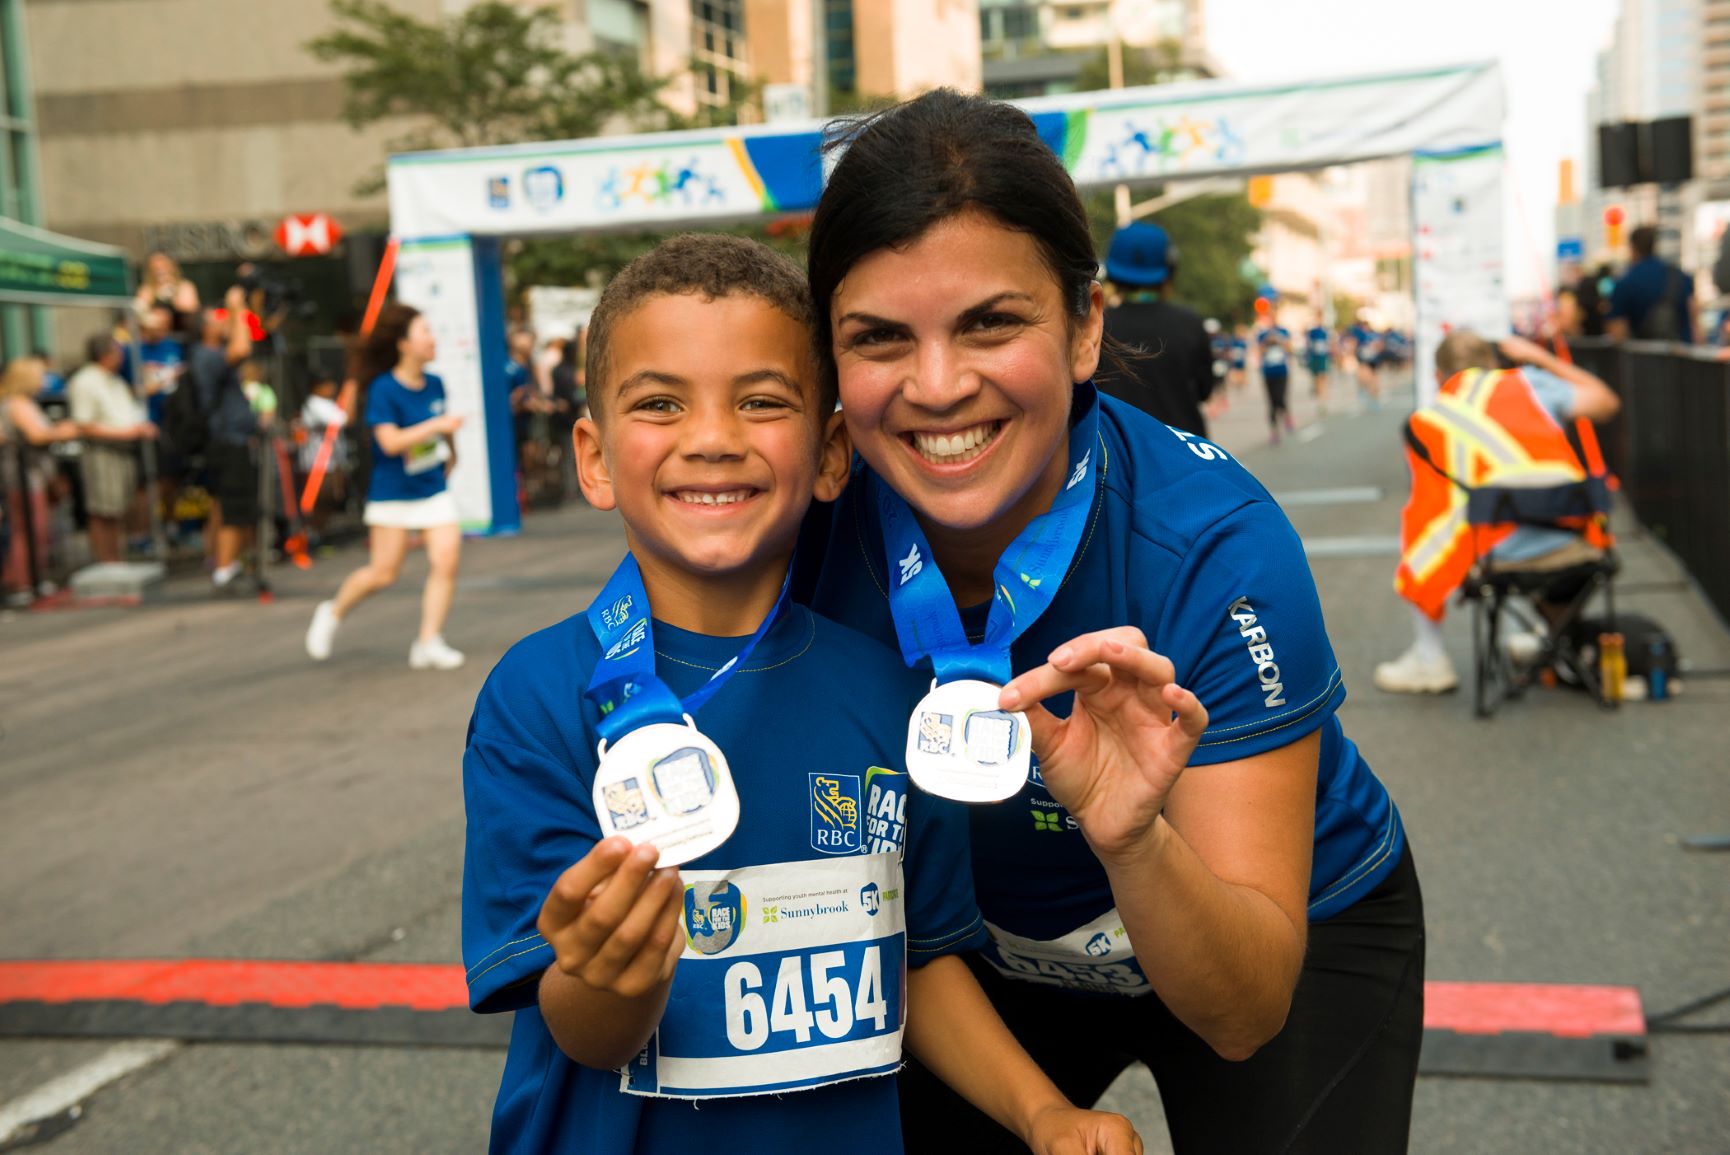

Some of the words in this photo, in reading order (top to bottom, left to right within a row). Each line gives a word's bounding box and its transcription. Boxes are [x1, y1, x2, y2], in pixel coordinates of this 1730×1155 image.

[601, 608, 616, 631] RBC
[1228, 596, 1286, 708] KARBON
[1030, 797, 1063, 807] Suppo
[817, 829, 855, 847] RBC
[762, 894, 792, 903] Supporting
[792, 892, 807, 900] youth
[862, 890, 879, 911] 5K
[780, 900, 849, 919] Sunnybrook
[1088, 935, 1111, 956] 5K
[724, 945, 887, 1051] 6454
